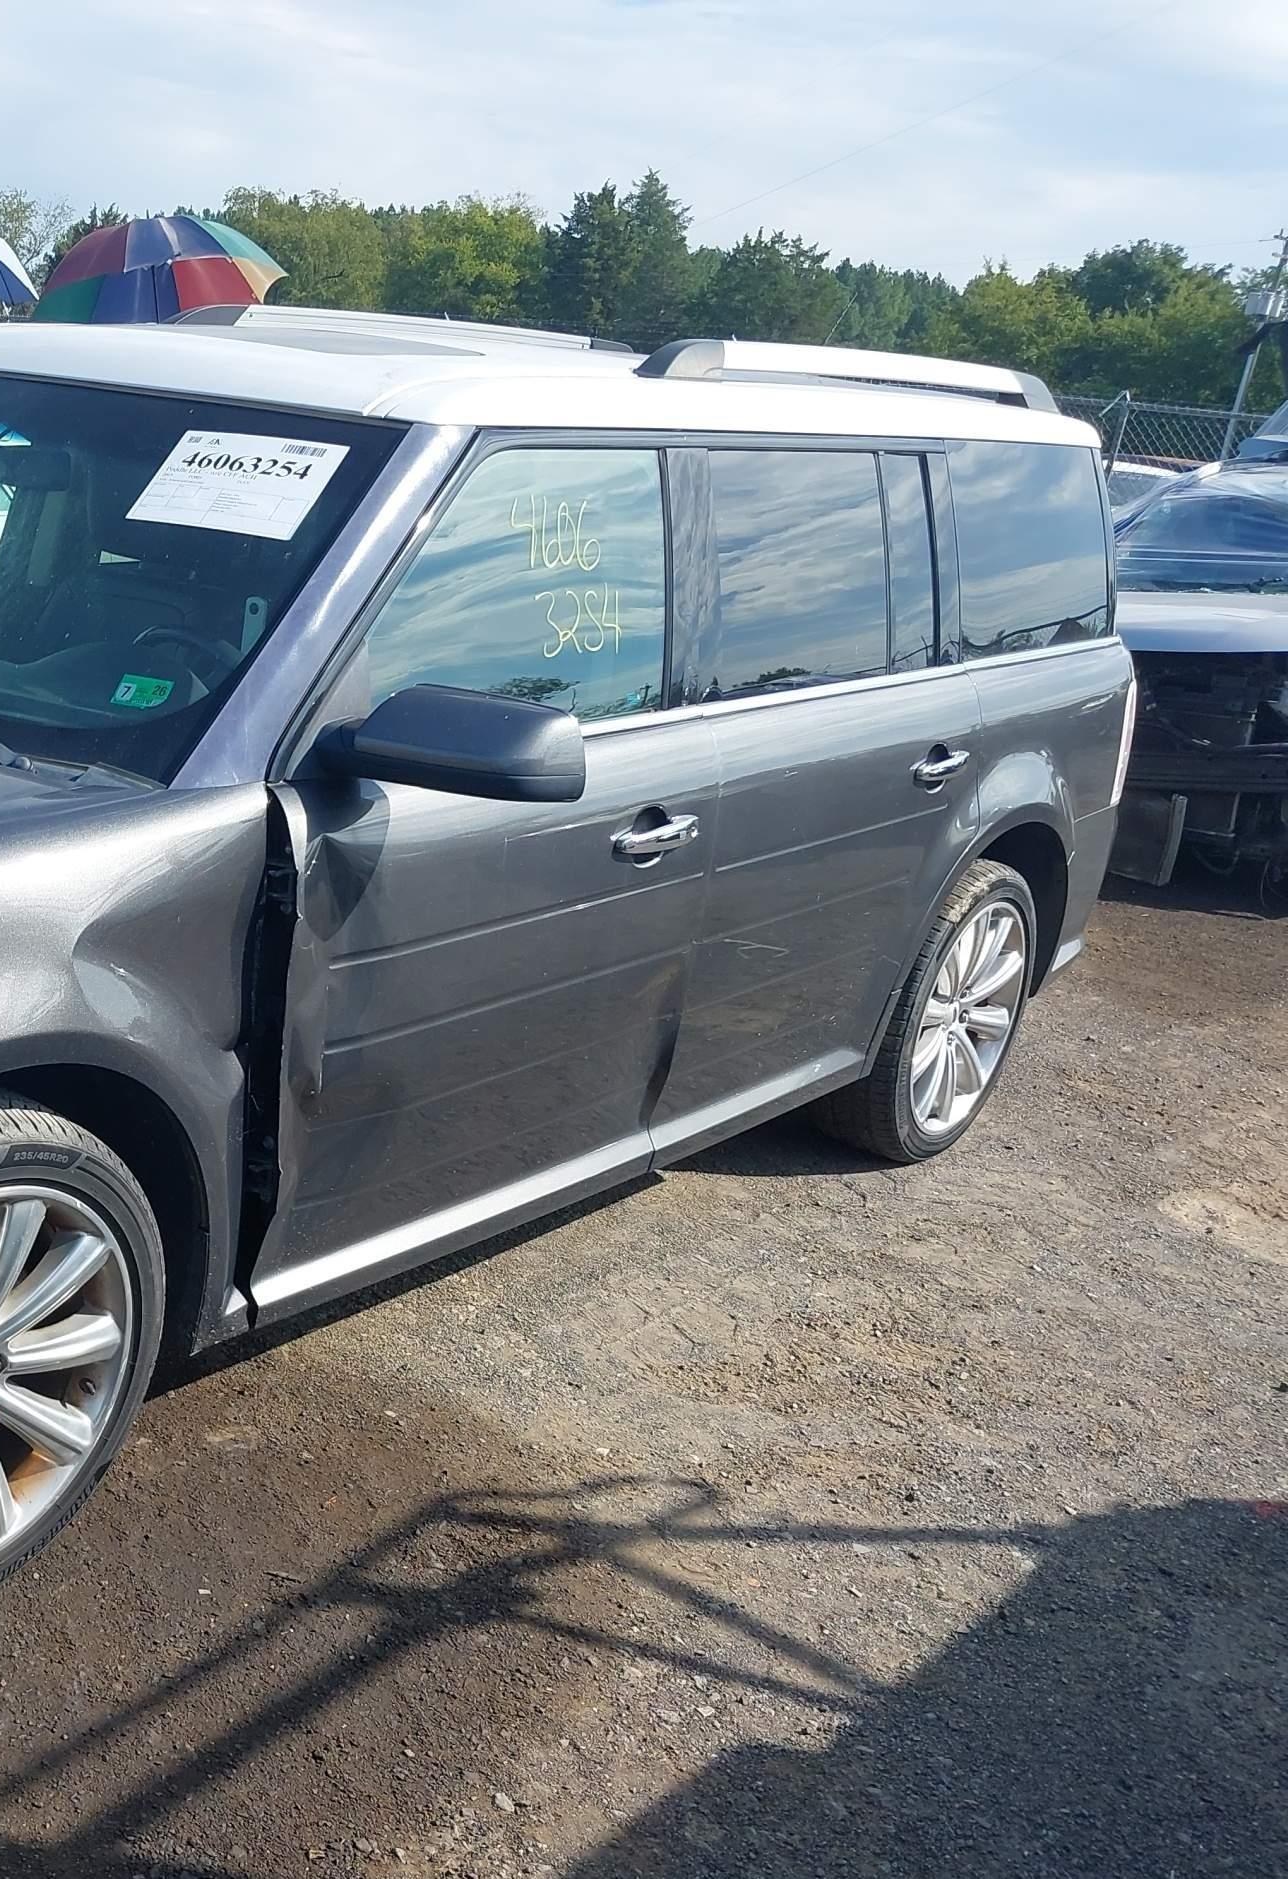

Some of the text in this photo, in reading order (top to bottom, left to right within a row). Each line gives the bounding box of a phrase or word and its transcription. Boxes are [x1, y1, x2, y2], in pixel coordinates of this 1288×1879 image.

[182, 451, 313, 480] 46063254
[510, 495, 601, 571] 4606
[120, 685, 132, 698] 7
